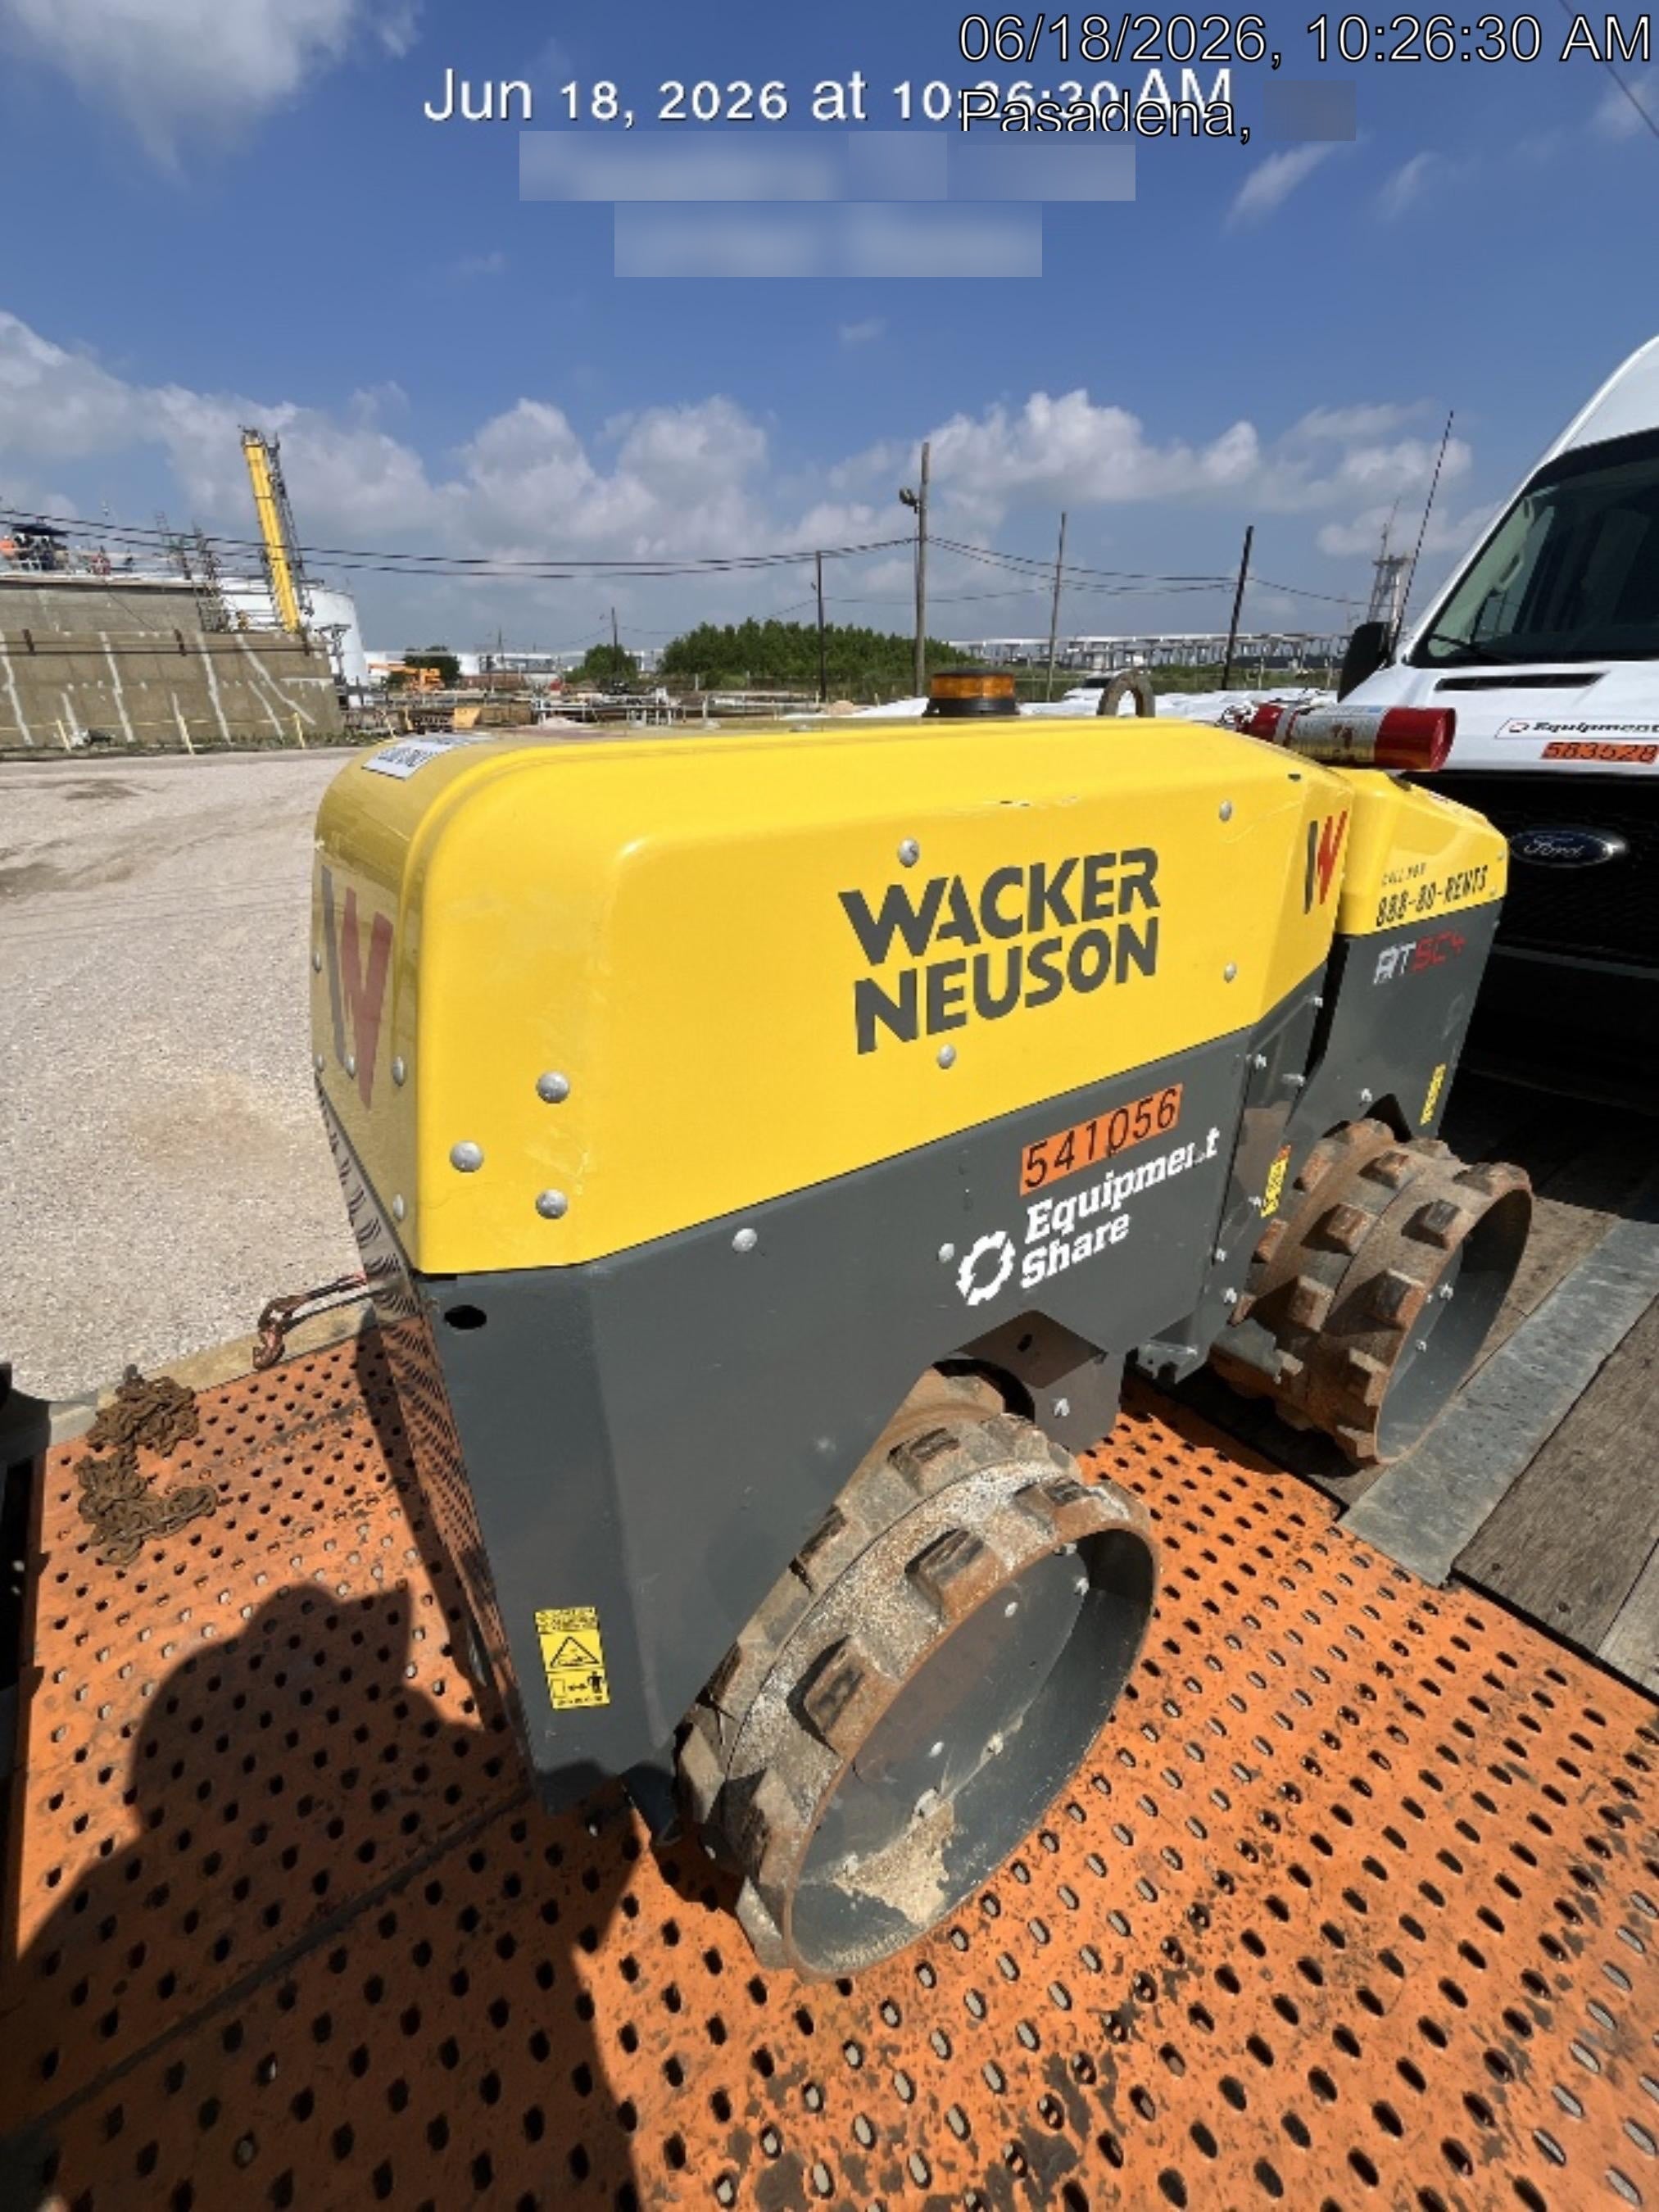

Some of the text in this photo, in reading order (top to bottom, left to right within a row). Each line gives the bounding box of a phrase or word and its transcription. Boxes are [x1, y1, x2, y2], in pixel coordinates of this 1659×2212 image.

[1523, 834, 1584, 857] Ford
[838, 847, 1161, 966] WACKER
[1376, 864, 1488, 927] 888-80-RENTS
[854, 916, 1159, 1055] NEUSON
[1024, 1087, 1178, 1188] 541056
[1020, 1213, 1131, 1289] Share
